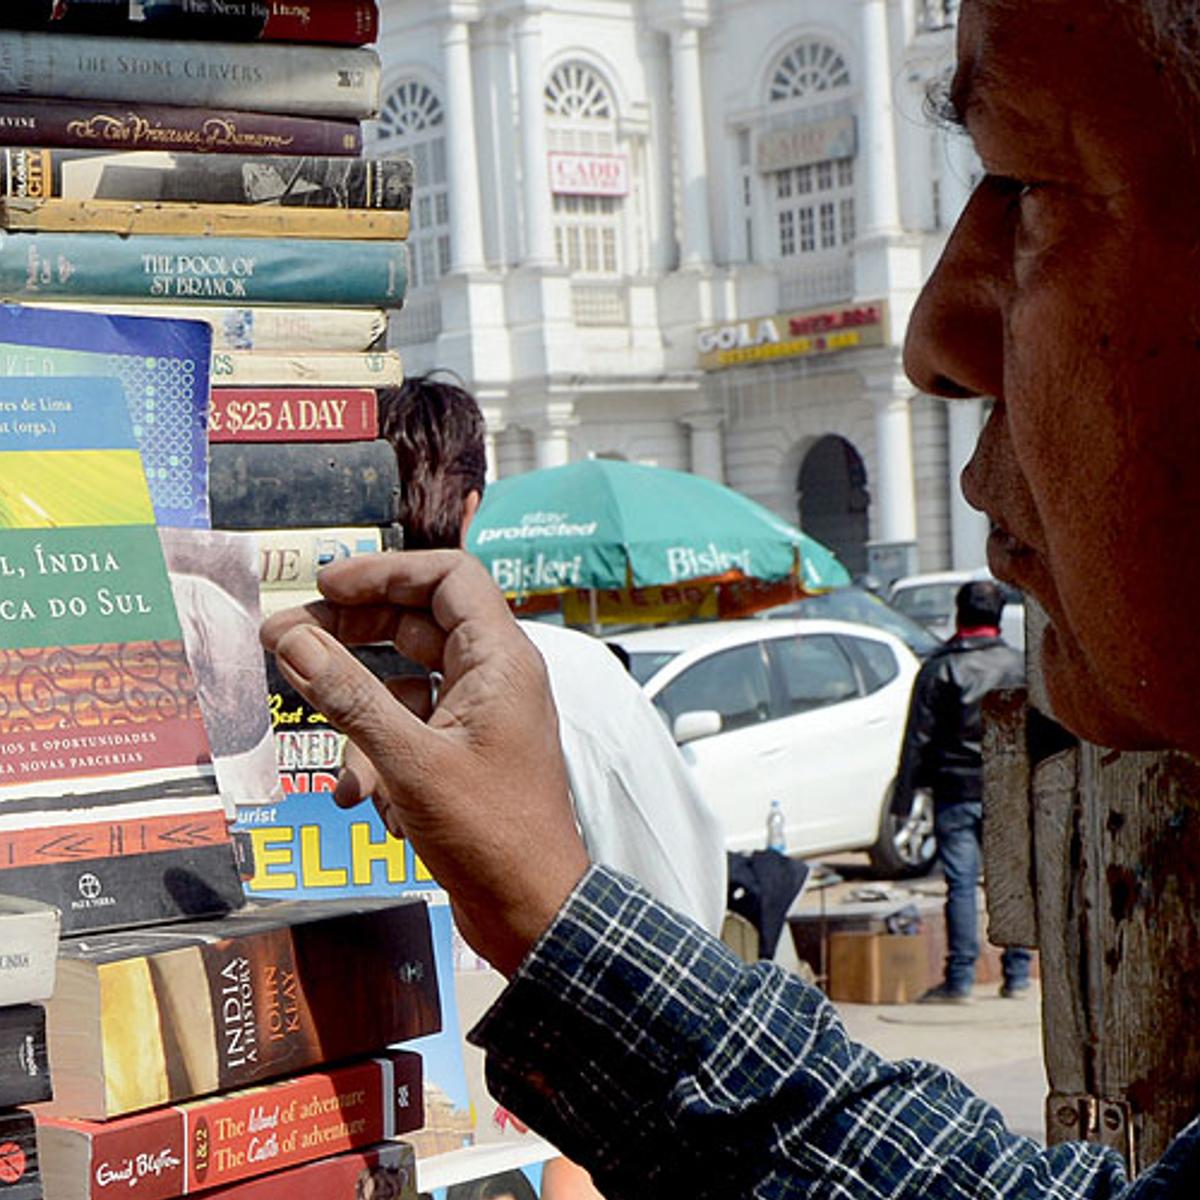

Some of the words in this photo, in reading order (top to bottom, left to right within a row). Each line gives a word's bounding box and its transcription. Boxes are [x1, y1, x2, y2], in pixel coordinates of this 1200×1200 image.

[184, 62, 261, 80] CARVERS
[180, 257, 227, 275] POOL
[227, 400, 272, 432] $25
[300, 400, 347, 430] DAY
[477, 521, 597, 543] protected
[36, 545, 120, 574] ÍNDIA
[49, 600, 87, 620] DO
[98, 589, 152, 616] SUL
[43, 731, 157, 750] OPORTUNIDADES
[69, 751, 142, 770] PARCERIAS
[221, 959, 245, 1067] INDIA
[264, 965, 284, 1041] JOHN
